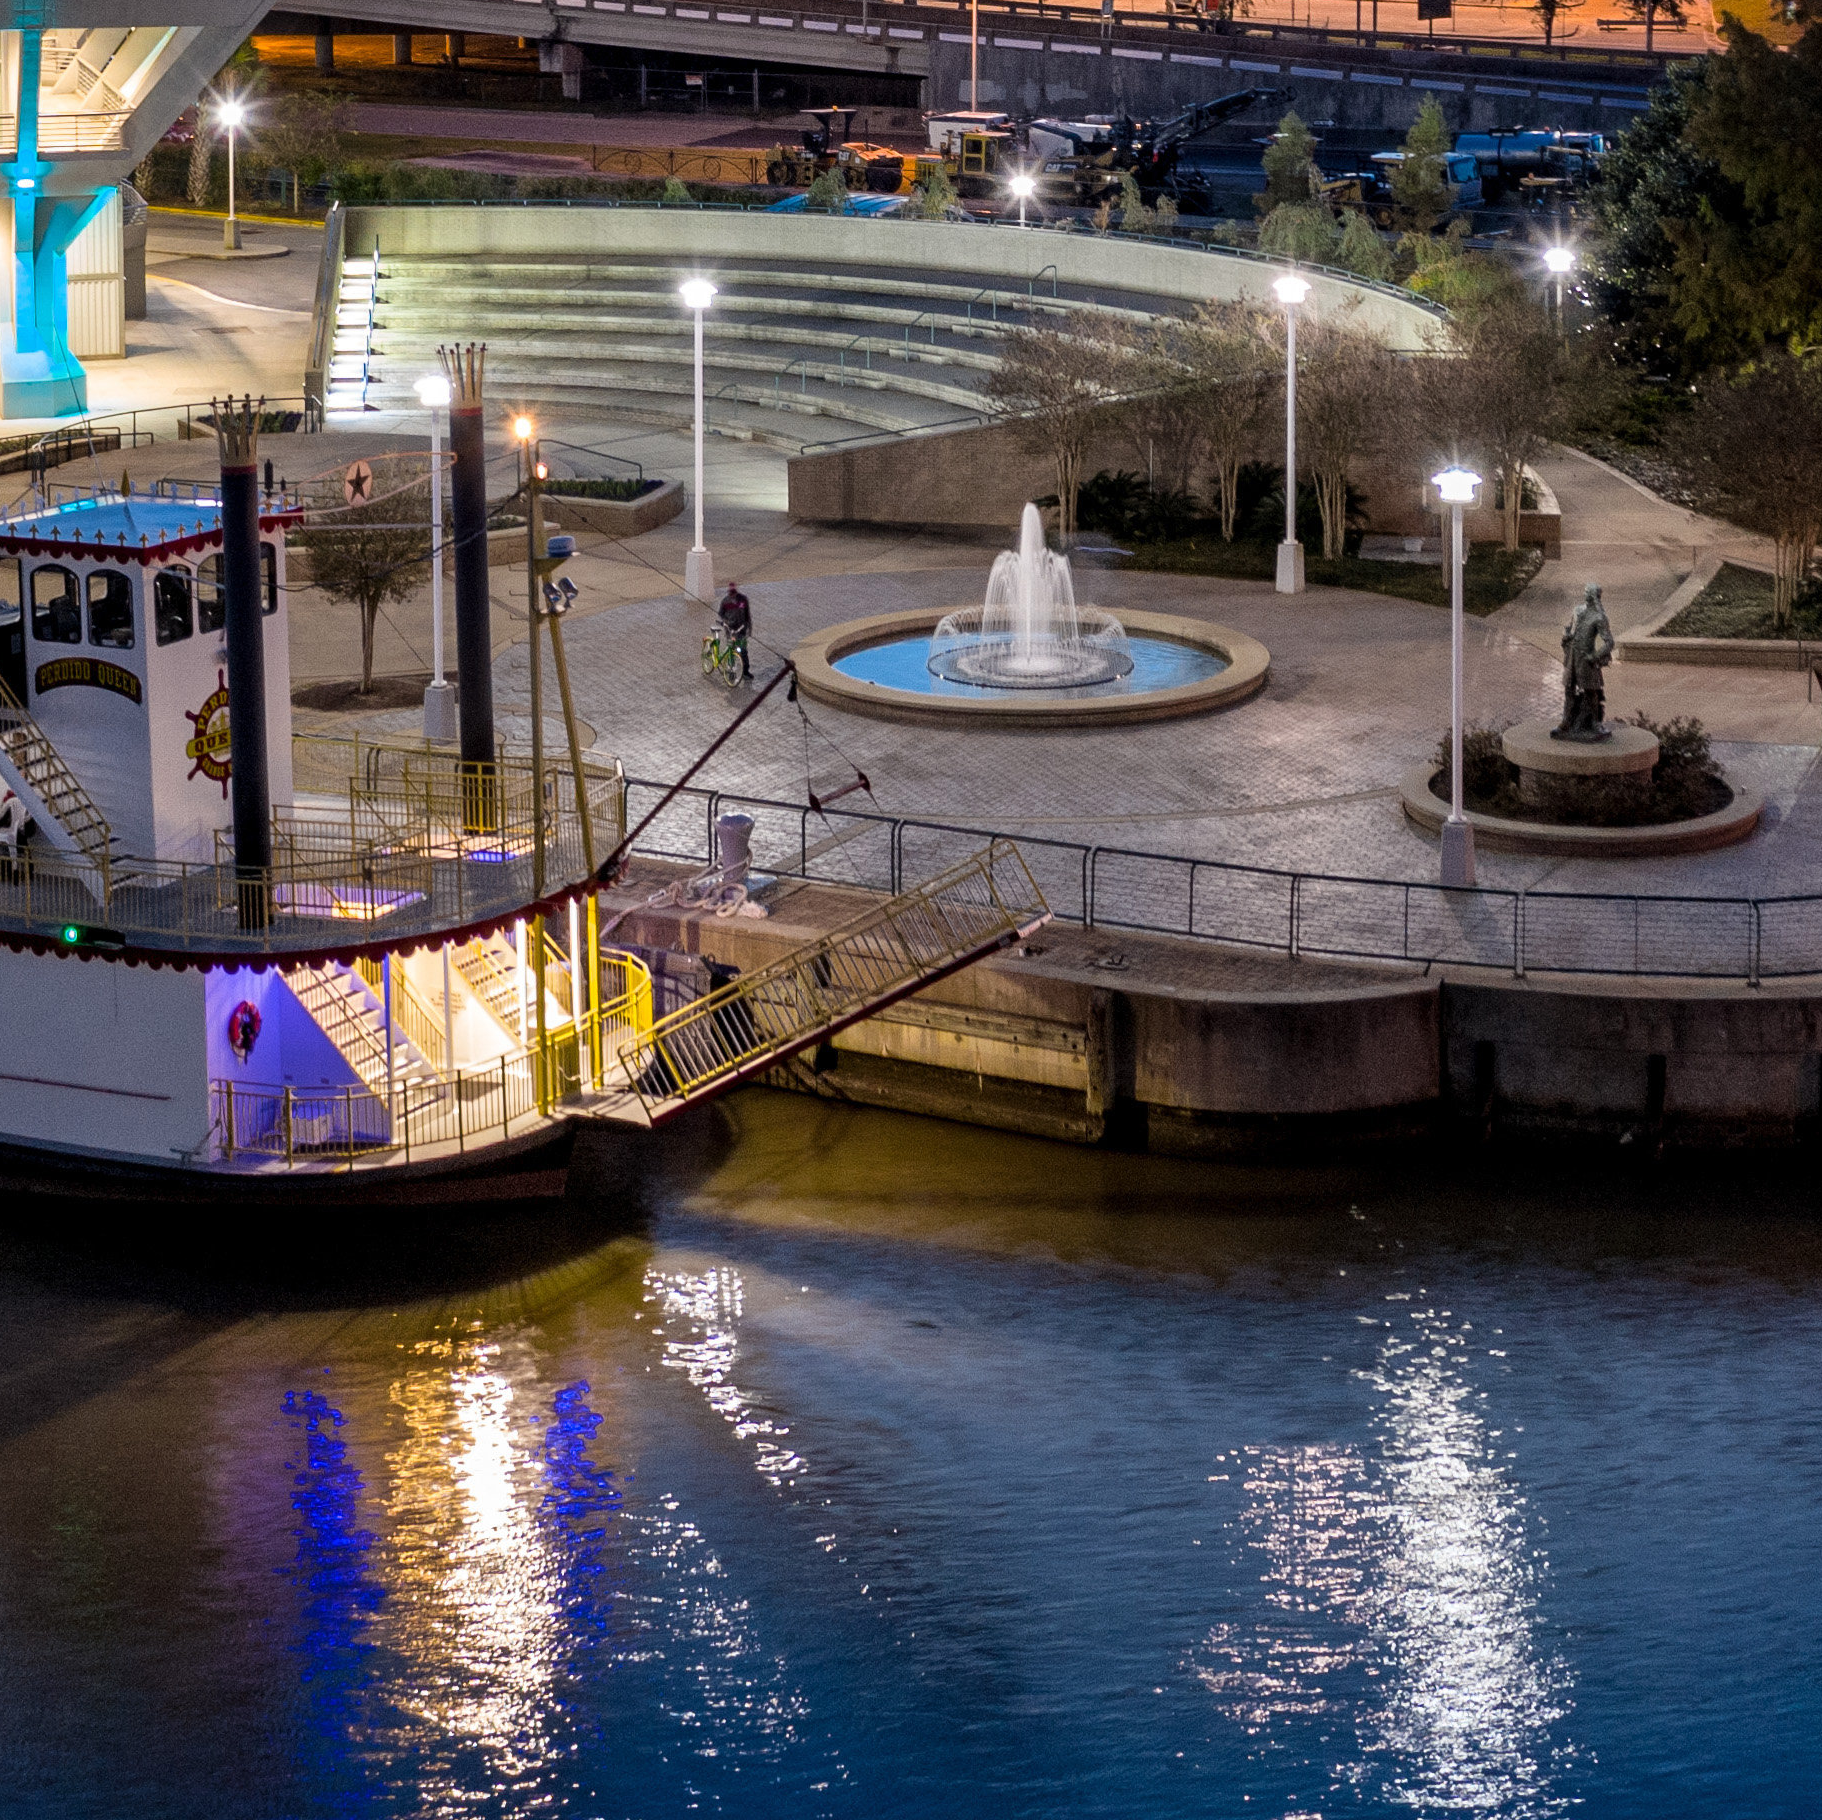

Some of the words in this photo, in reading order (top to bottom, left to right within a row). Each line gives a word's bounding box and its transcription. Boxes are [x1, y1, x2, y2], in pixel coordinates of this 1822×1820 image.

[40, 661, 91, 687] PERDIDO
[98, 664, 137, 696] QUEEN
[197, 691, 228, 730] PERD
[193, 731, 229, 754] QUE
